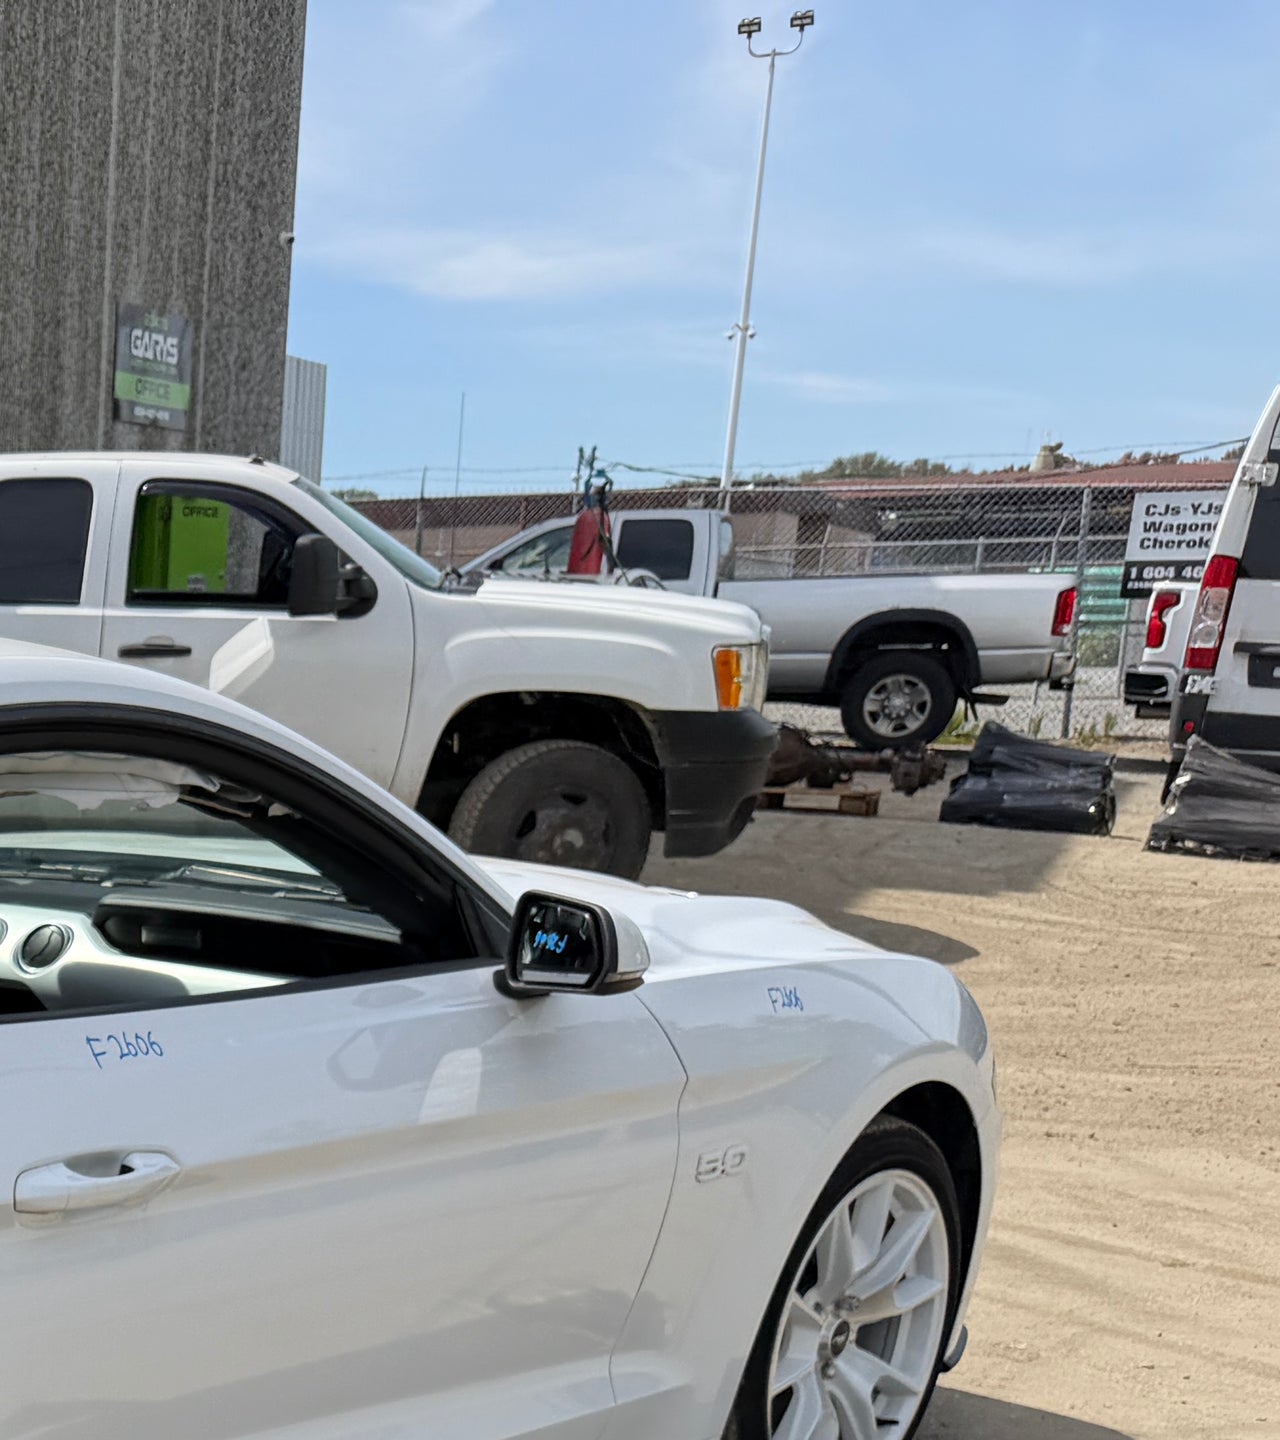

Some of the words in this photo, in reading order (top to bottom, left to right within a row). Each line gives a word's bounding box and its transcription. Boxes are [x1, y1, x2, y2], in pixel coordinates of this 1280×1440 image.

[1140, 536, 1210, 550] Cherok
[1130, 566, 1137, 579] 1
[86, 1031, 163, 1069] F2606
